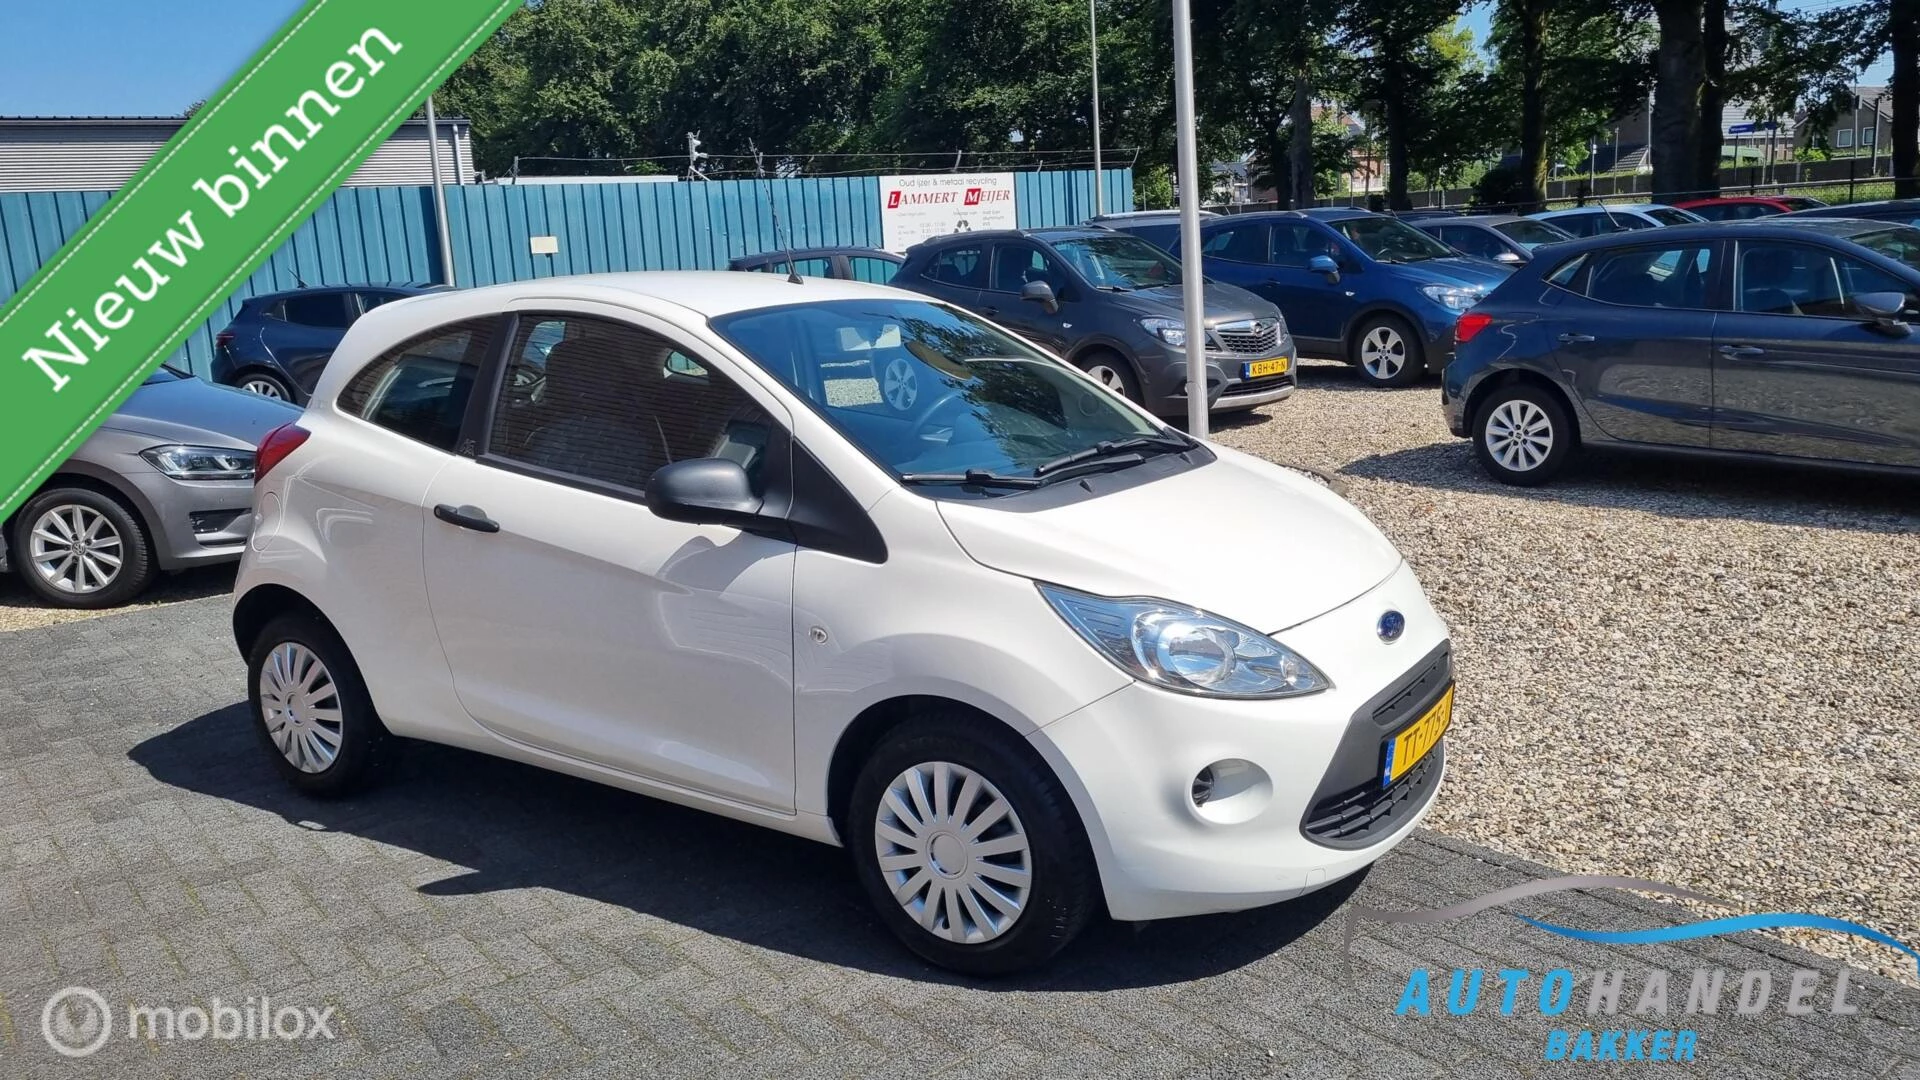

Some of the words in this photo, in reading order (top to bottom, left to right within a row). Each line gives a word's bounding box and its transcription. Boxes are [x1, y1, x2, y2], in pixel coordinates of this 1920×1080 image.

[899, 178, 915, 187] Oud
[933, 178, 938, 186] &
[940, 177, 964, 186] metaal
[966, 176, 997, 187] recycling
[887, 191, 958, 208] LAMMERT
[964, 188, 1010, 205] MEIJER
[1252, 361, 1285, 374] KBH-47-N
